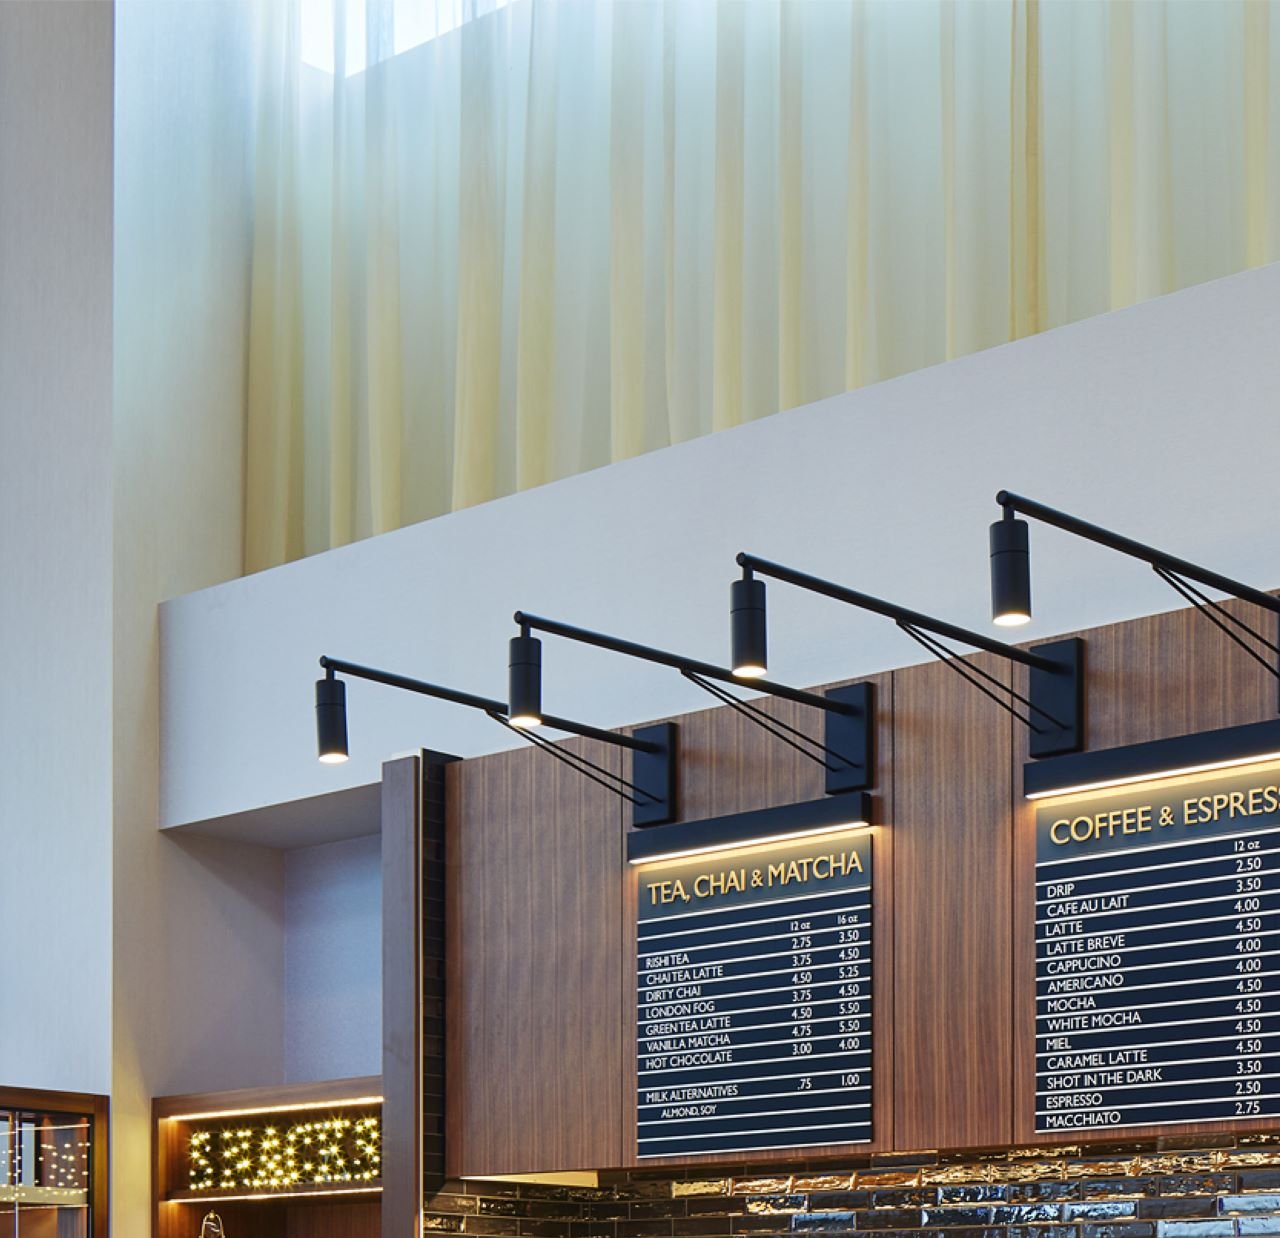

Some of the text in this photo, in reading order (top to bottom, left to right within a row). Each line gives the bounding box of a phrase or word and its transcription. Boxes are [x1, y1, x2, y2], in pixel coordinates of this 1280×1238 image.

[1050, 806, 1152, 845] COFFEE
[1159, 805, 1174, 826] &
[648, 850, 863, 905] TEA, CHAI & MATCHA
[1047, 883, 1074, 898] DRIP
[1236, 857, 1261, 872] 2.50
[1047, 902, 1078, 917] CAFE
[1079, 899, 1097, 913] AU
[1101, 895, 1128, 910] LAIT
[1236, 877, 1261, 892] 3.50
[1045, 920, 1082, 936] LATTE
[1234, 897, 1259, 913] 4.00
[670, 953, 689, 965] TEA
[792, 936, 811, 949] 2.75
[839, 930, 859, 943] 3.50
[1046, 939, 1083, 955] LATTE
[1087, 934, 1125, 950] BREVE
[1235, 918, 1261, 933] 4.50
[646, 948, 859, 985] CHAI TEA LATTE 3.75 4.50
[1047, 954, 1120, 974] CAPPUCINO
[1235, 938, 1261, 953] 4.00
[646, 966, 858, 1002] DIRTY CHAI 4.50 5.25
[1047, 974, 1123, 993] AMERICANO
[1235, 958, 1261, 973] 4.00
[646, 984, 859, 1019] LONDON FOG 3.75 4.50
[1047, 996, 1095, 1012] MOCHA
[1236, 978, 1261, 993] 4.50
[646, 1002, 859, 1035] GREEN TEA LATTE 4.50 5.50
[1047, 1016, 1088, 1032] WHITE
[1091, 1011, 1141, 1027] MOCHA
[1235, 999, 1261, 1013] 4.50
[646, 1020, 859, 1052] VANILLA MATCHA 4.75 5.50
[1046, 1037, 1071, 1051] MIEL
[1235, 1019, 1261, 1034] 4.50
[646, 1038, 859, 1069] HOT CHOCOLATE 3.00 4.00
[1047, 1053, 1105, 1070] CARAMEL
[1109, 1050, 1147, 1065] LATTE
[1235, 1040, 1261, 1054] 4.50
[646, 1091, 668, 1103] MILK
[670, 1085, 737, 1101] ALTERNATIVES
[841, 1074, 859, 1086] 1.00
[1047, 1075, 1081, 1089] SHOT
[1084, 1074, 1097, 1086] IN
[1098, 1071, 1123, 1085] THE
[1126, 1068, 1161, 1083] DARK
[1236, 1060, 1261, 1074] 3.50
[700, 1105, 716, 1115] SOY
[1046, 1093, 1102, 1108] ESPRESSO
[1235, 1080, 1260, 1094] 2.50
[1046, 1111, 1120, 1127] MACCHIATO
[1235, 1101, 1260, 1114] 2.75
